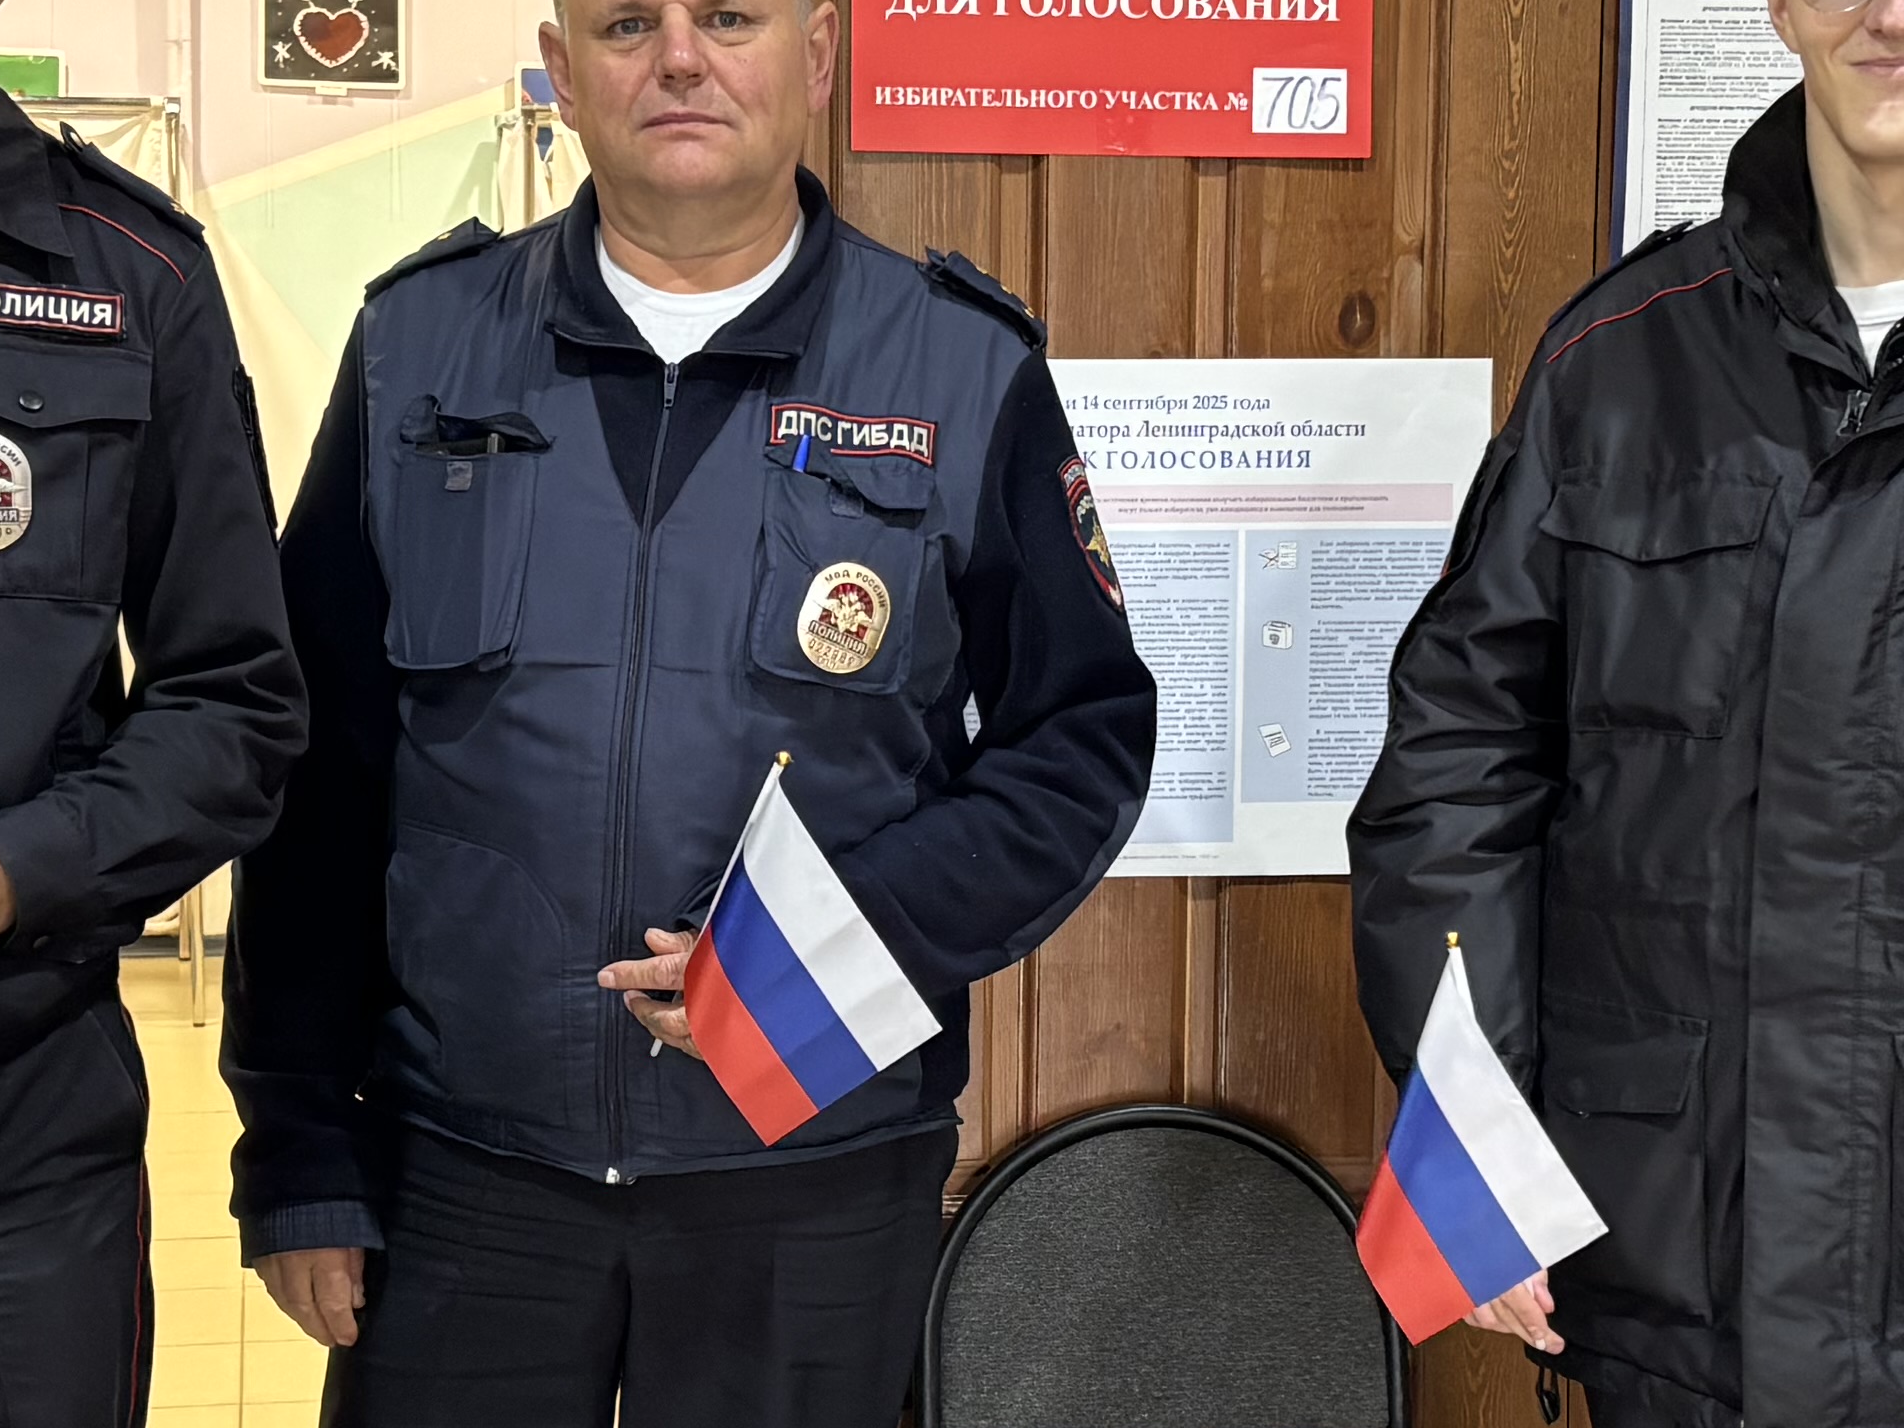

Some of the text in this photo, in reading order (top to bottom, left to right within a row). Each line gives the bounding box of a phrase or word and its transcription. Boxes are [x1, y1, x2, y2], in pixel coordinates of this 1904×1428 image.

[874, 75, 1343, 131] ИЗБИРАТЕЛЬНОГО УЧАСТКА № 705
[1065, 395, 1271, 414] и 14 сентября 2025 года
[778, 410, 929, 457] ДПС ГИБДД
[1136, 420, 1285, 444] Ленинградской
[1290, 419, 1366, 437] области
[1105, 449, 1312, 470] ГОЛОСОВАНИЯ
